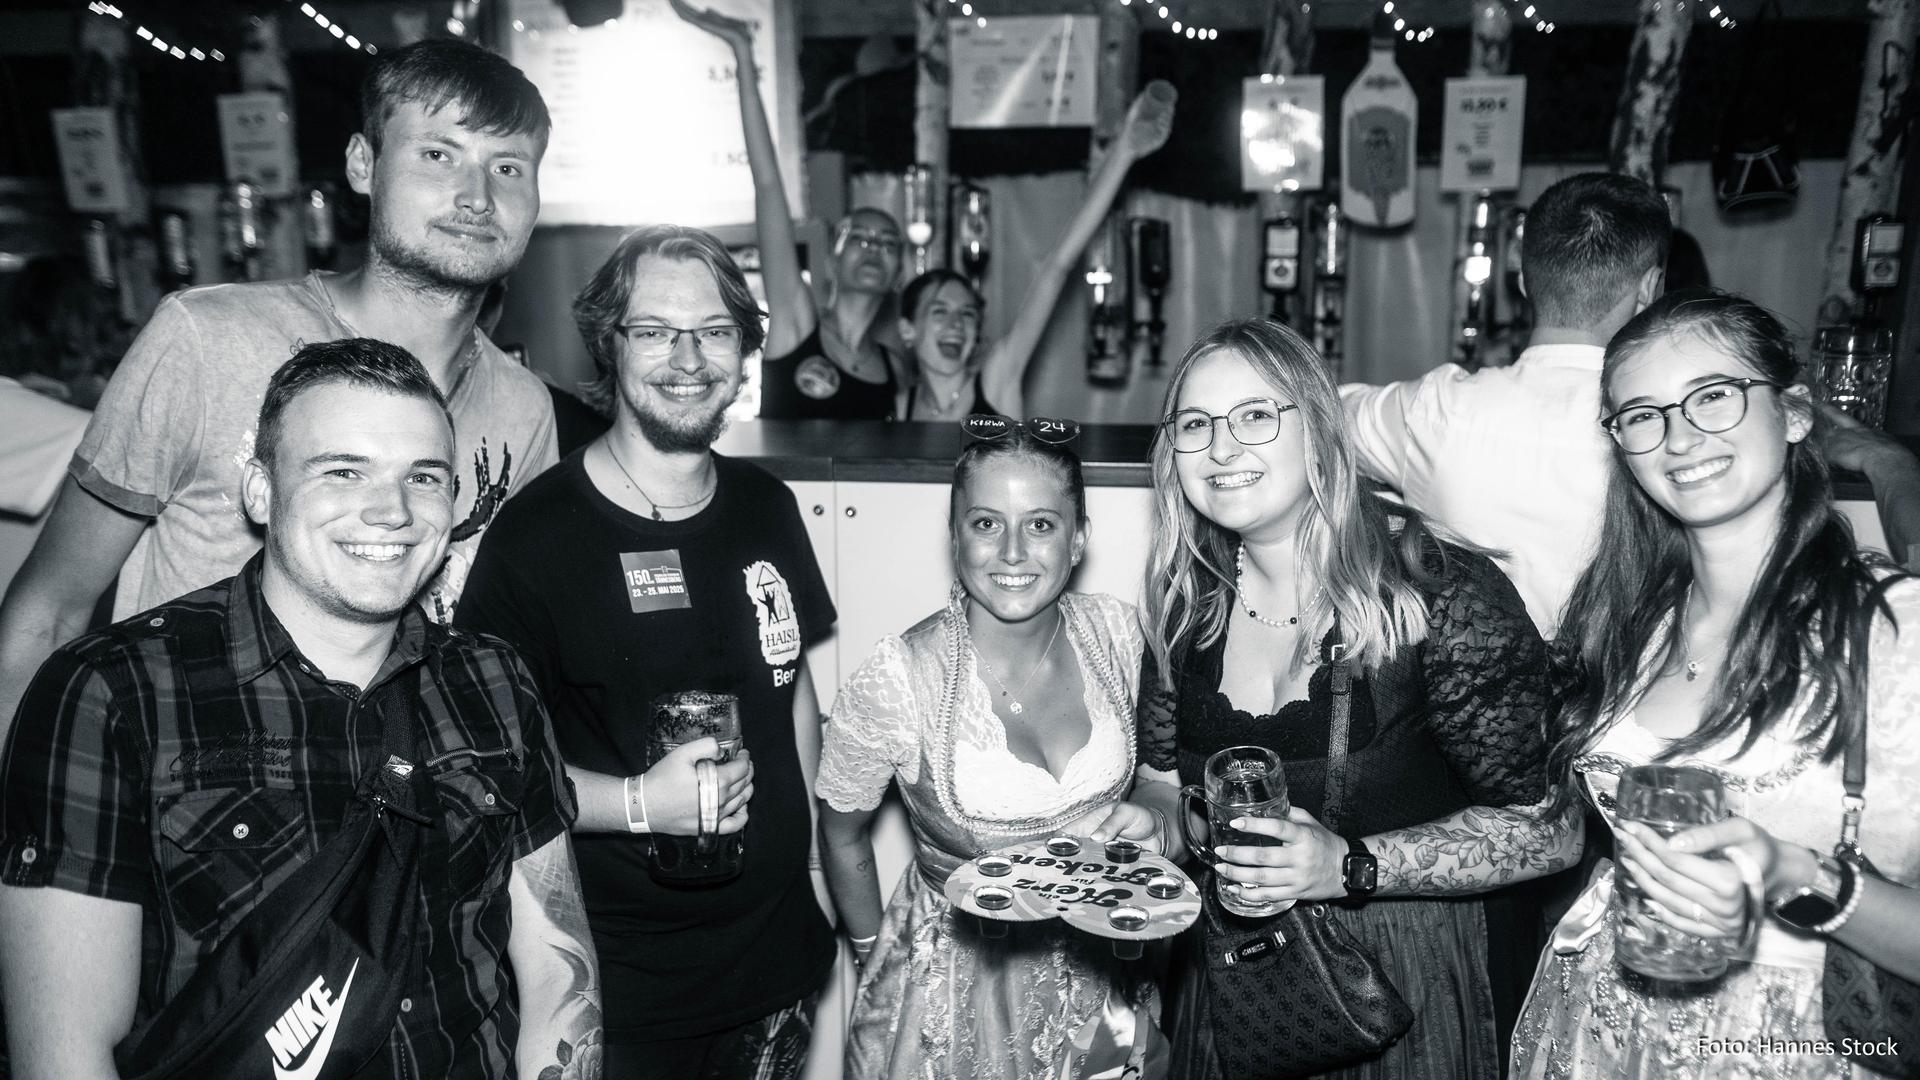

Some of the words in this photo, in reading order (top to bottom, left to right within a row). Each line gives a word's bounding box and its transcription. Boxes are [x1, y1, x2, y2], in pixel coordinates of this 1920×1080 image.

[765, 628, 799, 648] HAISL
[1012, 879, 1134, 908] Herz
[264, 974, 340, 1069] NIKE
